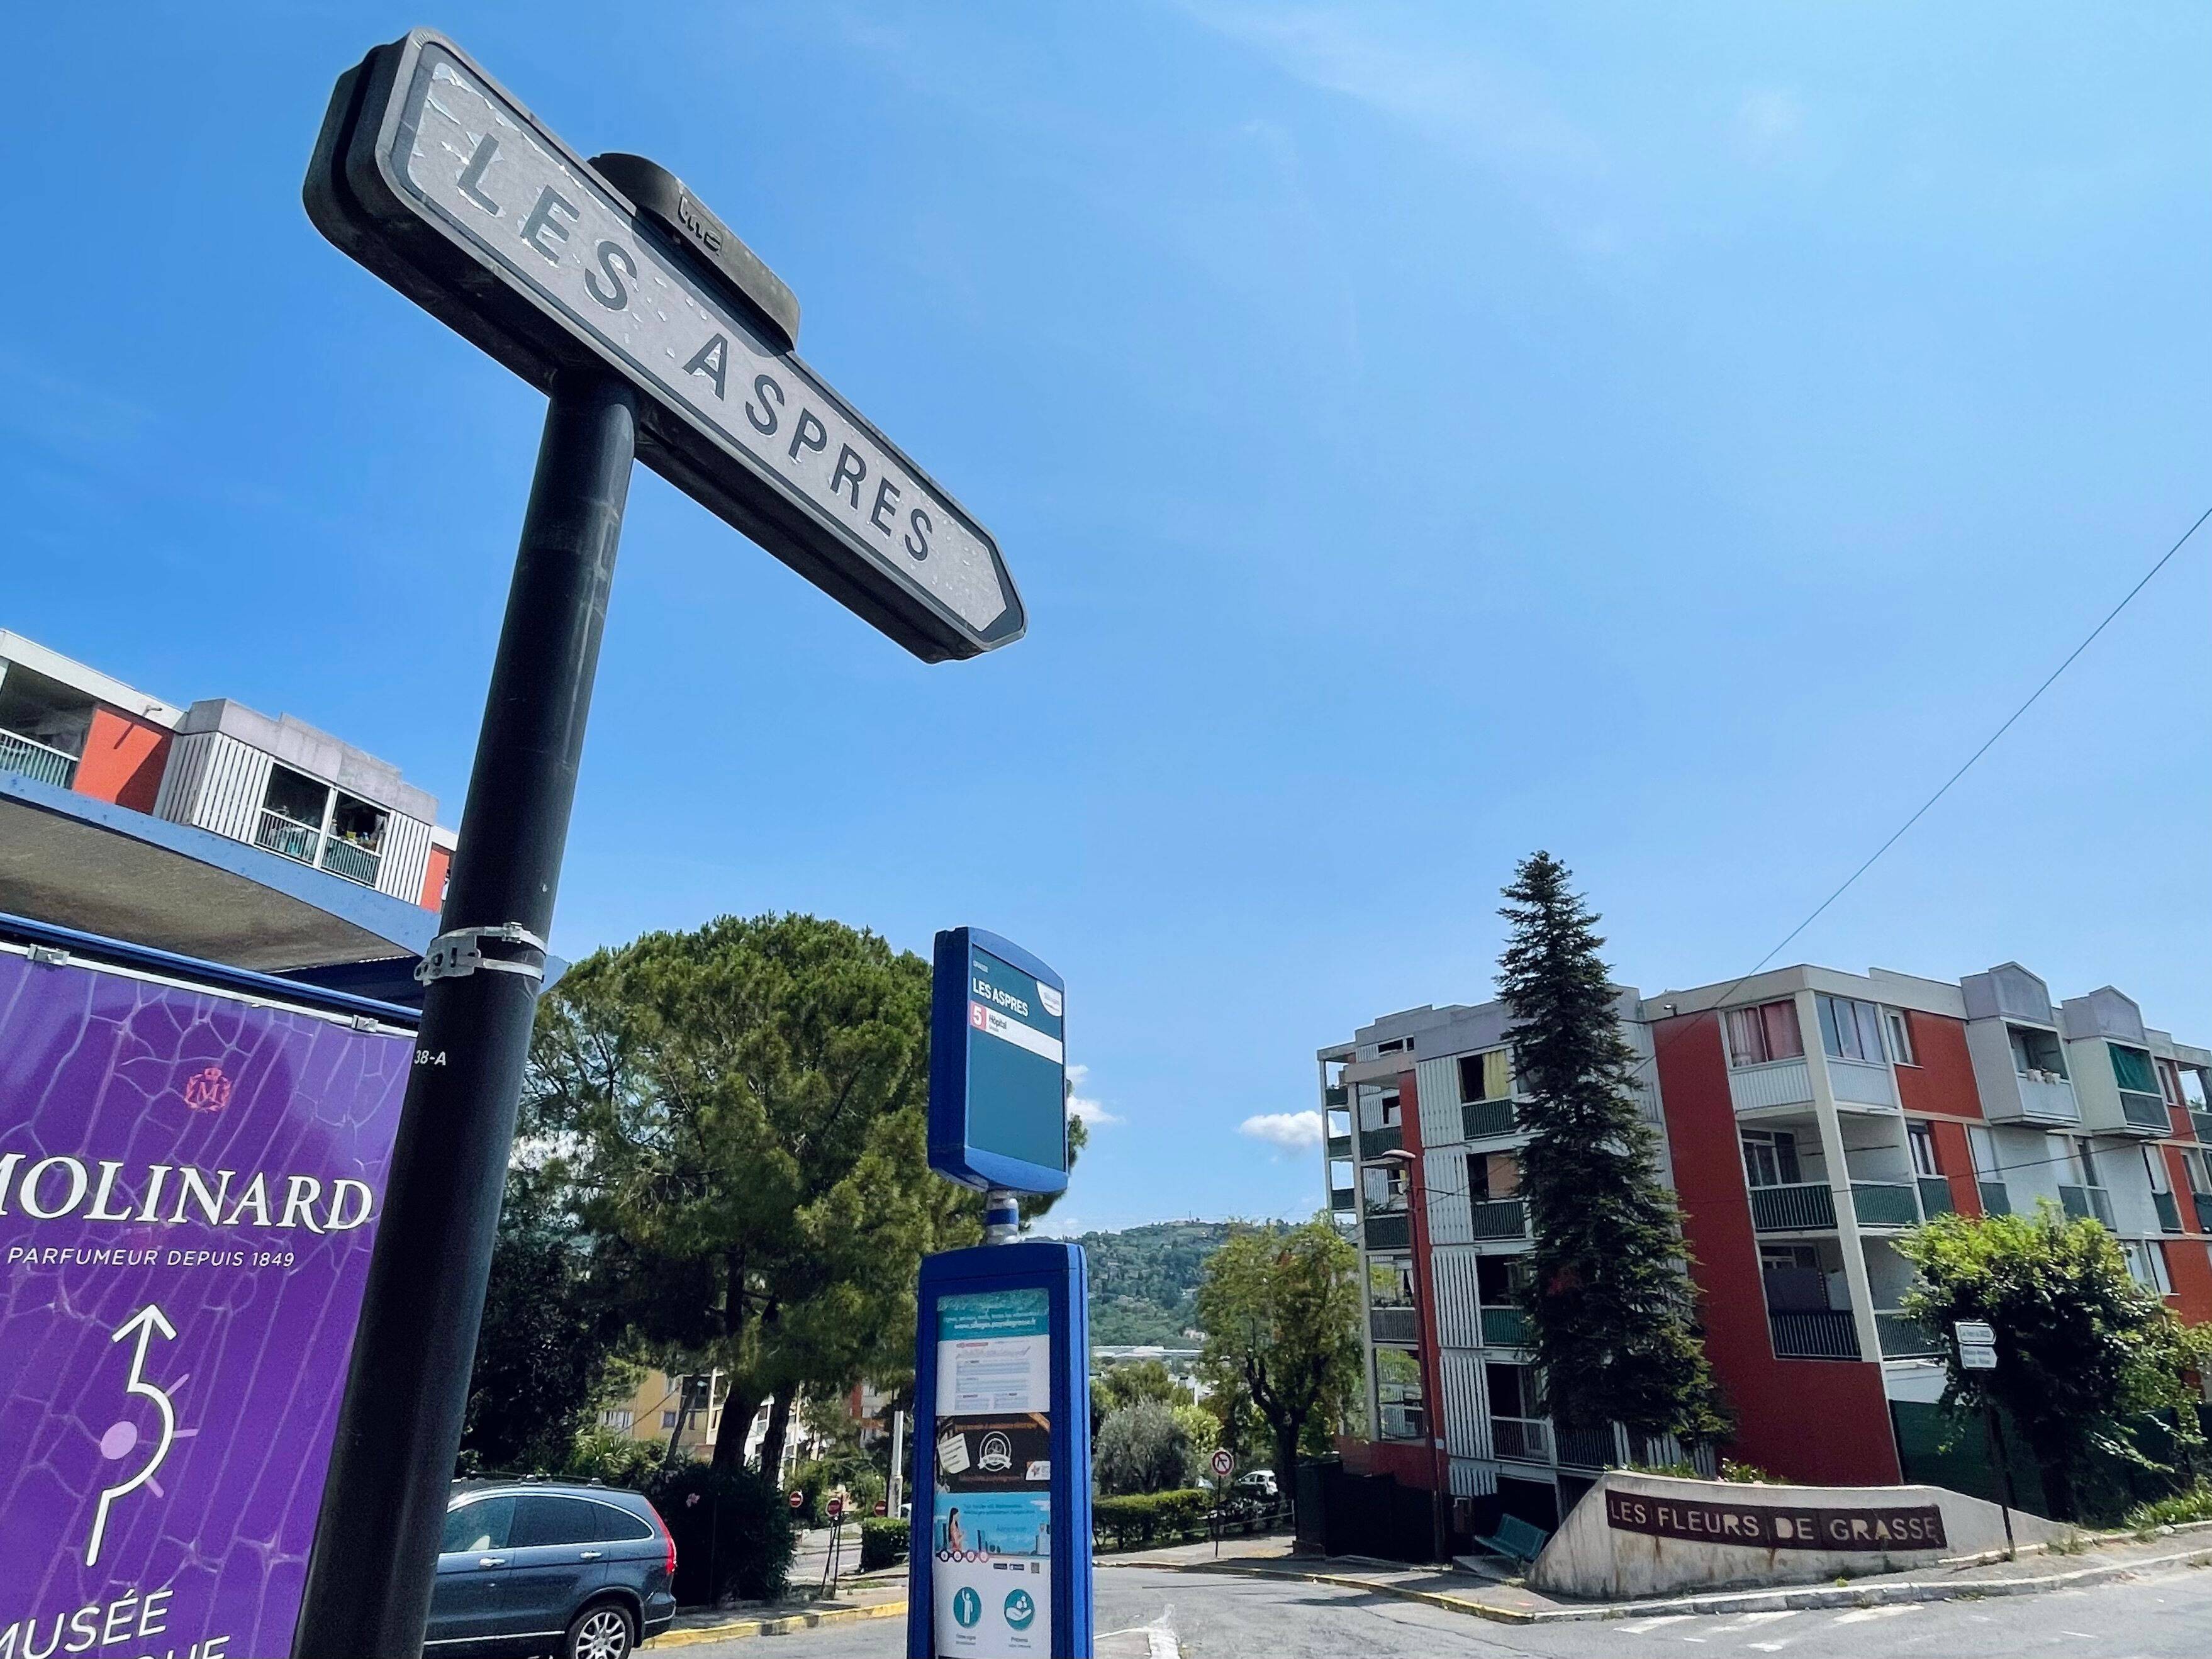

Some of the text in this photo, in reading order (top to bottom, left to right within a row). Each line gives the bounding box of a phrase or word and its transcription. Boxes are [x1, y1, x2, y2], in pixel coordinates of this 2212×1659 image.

[457, 132, 933, 562] LES ASPRES
[973, 977, 991, 999] LES
[992, 988, 1029, 1017] ASPRES
[973, 1005, 982, 1025] 5
[414, 1049, 446, 1066] 38-A
[8, 1247, 295, 1267] PARFUMEUR DEPUIS 1849
[1610, 1500, 1937, 1541] LES FLEURS DE GRASSE
